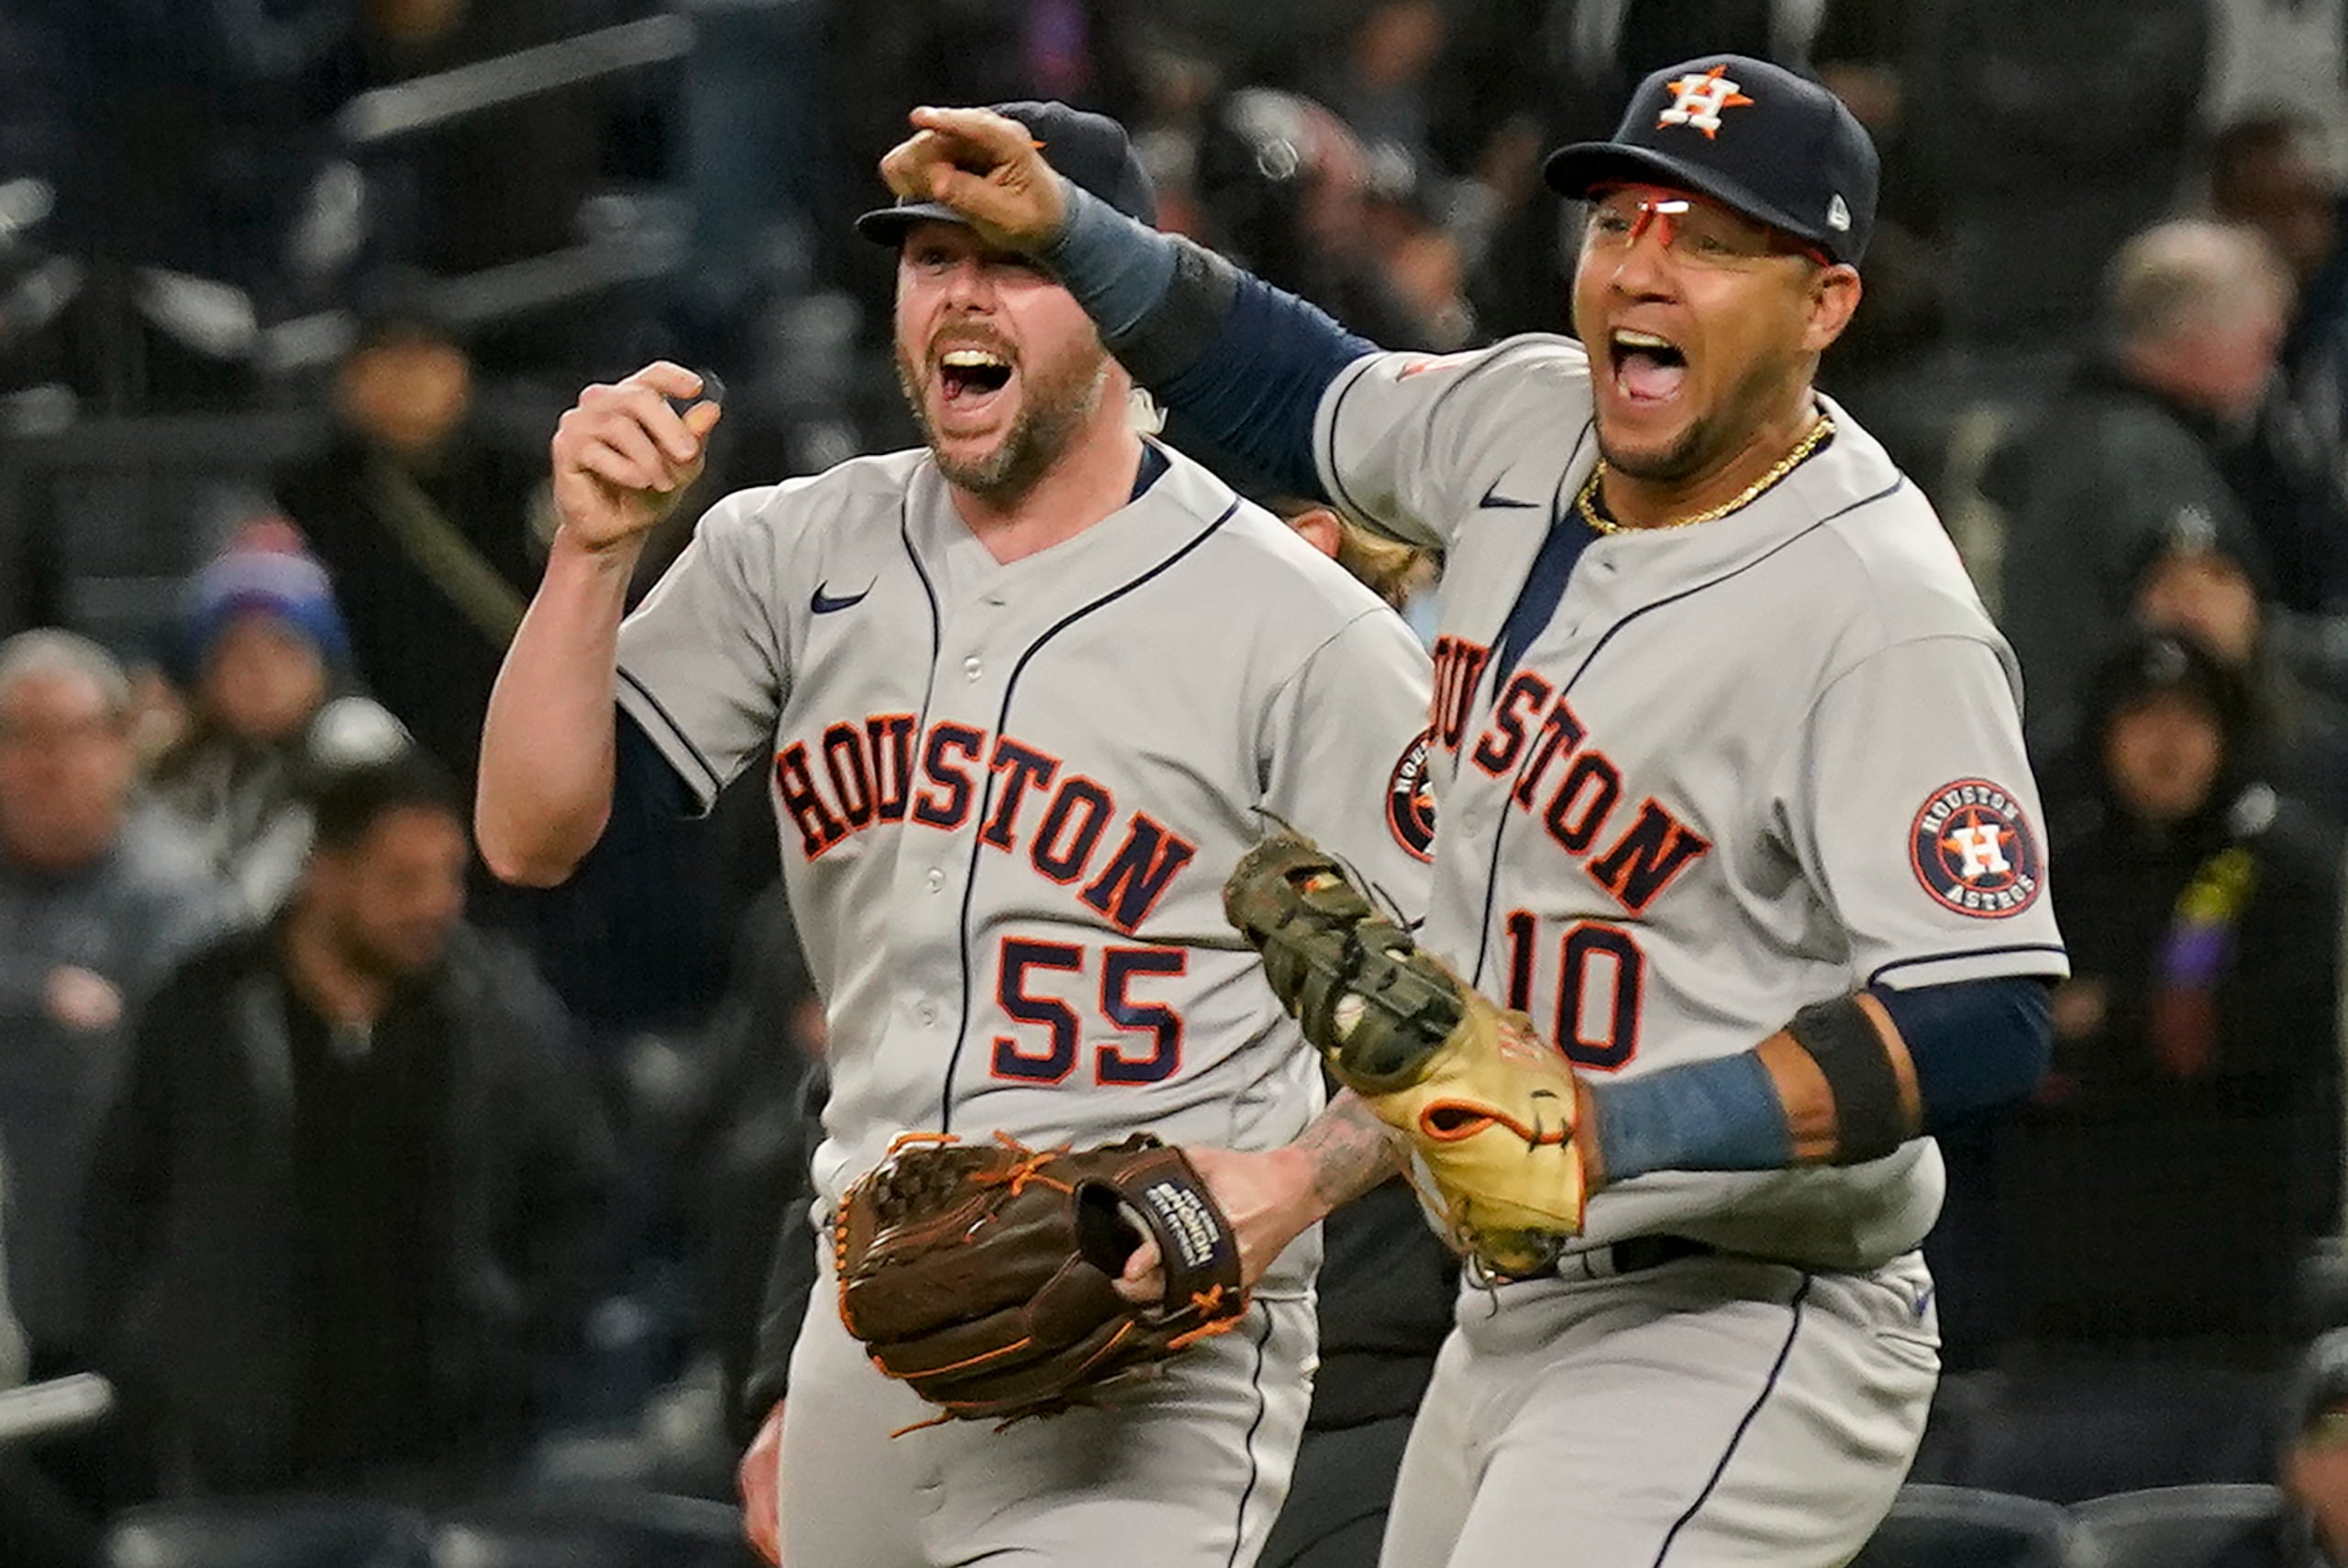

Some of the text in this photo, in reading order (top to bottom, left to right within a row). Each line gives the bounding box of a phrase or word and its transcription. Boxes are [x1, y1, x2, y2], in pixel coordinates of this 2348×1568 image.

[775, 712, 1197, 935] HOUSTON
[1922, 786, 2019, 834] HOUSTON
[1945, 874, 2035, 911] ASTROS
[990, 935, 1188, 1086] 55
[1506, 908, 1646, 1073] 10
